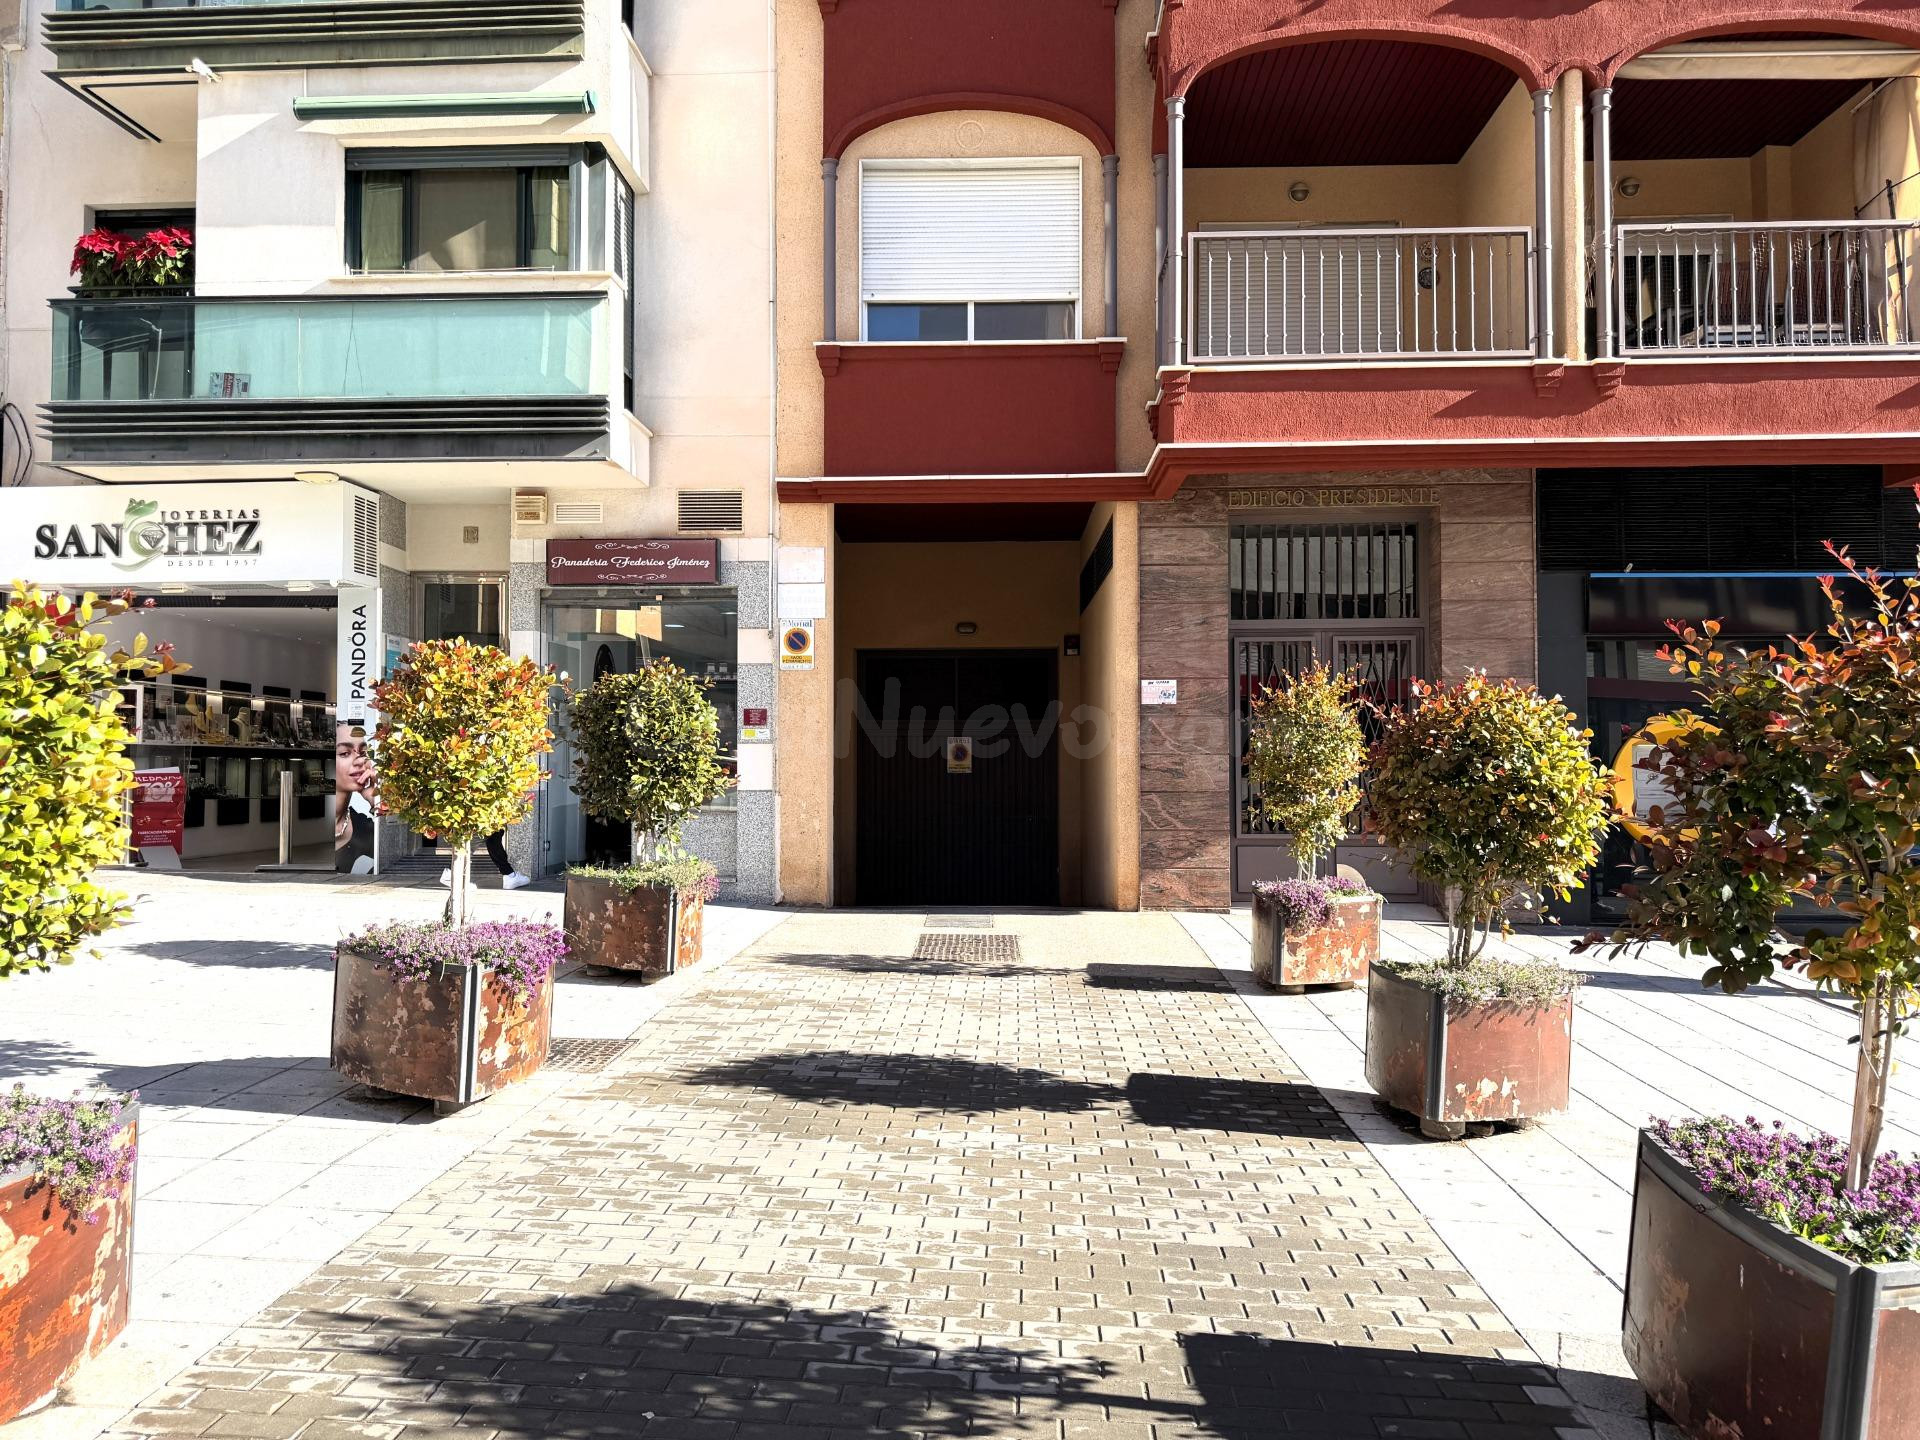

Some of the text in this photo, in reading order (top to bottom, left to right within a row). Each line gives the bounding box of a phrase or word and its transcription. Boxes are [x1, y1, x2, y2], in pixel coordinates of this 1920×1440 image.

[1228, 487, 1441, 507] EDIFICIO PRESIDENTE
[160, 508, 261, 524] JOYERIAS
[167, 558, 258, 568] DESDE 1957
[611, 556, 665, 569] Federico
[667, 556, 711, 570] Jiménez
[351, 604, 367, 699] PANDORA
